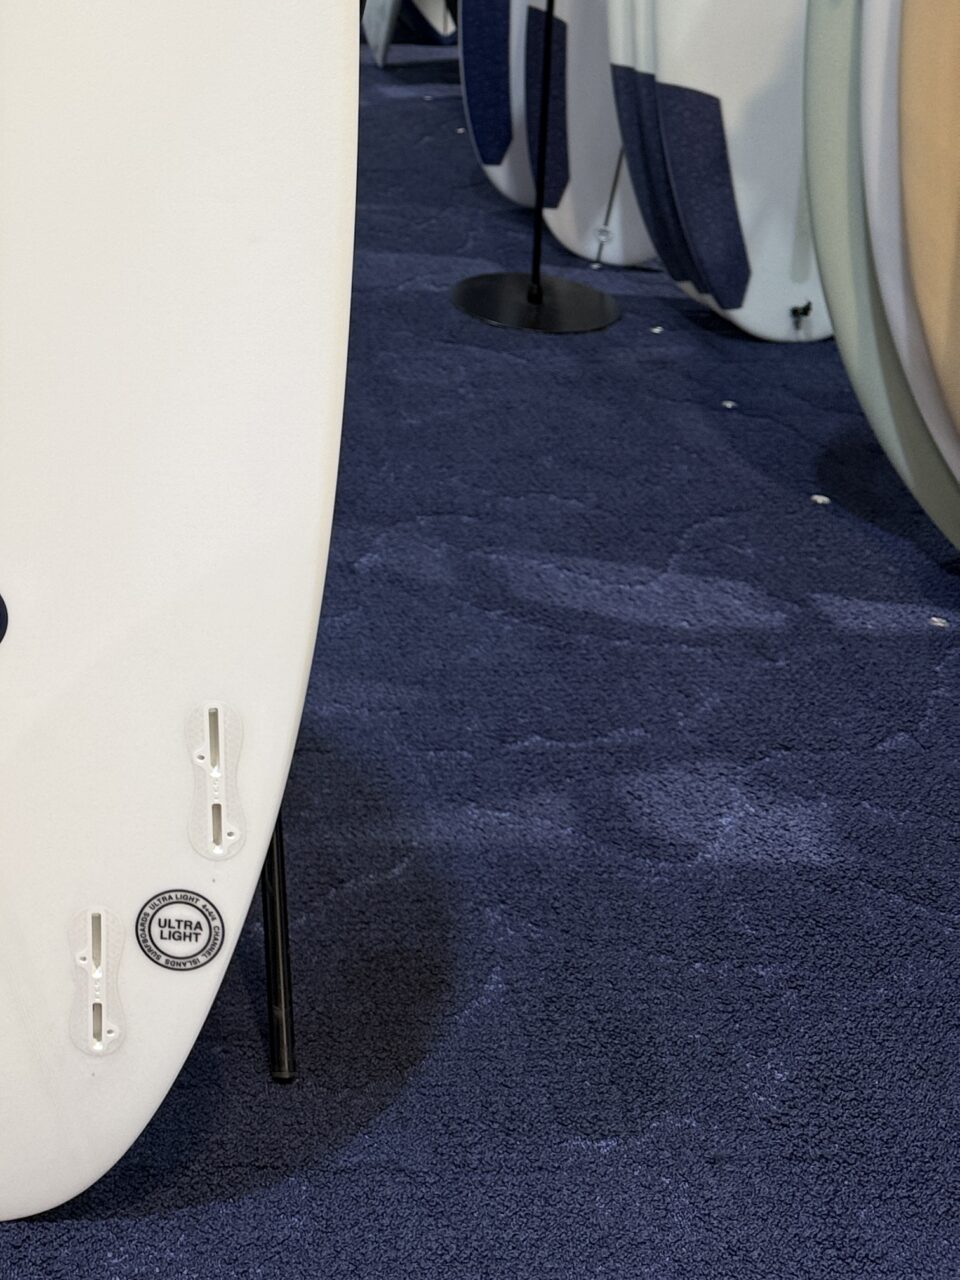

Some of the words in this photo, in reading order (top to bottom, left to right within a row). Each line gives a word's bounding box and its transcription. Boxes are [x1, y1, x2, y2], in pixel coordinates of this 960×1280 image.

[148, 894, 174, 911] ULTRA
[175, 893, 201, 904] LIGHT
[158, 918, 203, 931] ULTRA
[139, 911, 162, 961] SURFBOARDS
[159, 930, 202, 942] LIGHT
[201, 925, 221, 959] CHANNEL
[164, 958, 201, 967] ISLANDS
